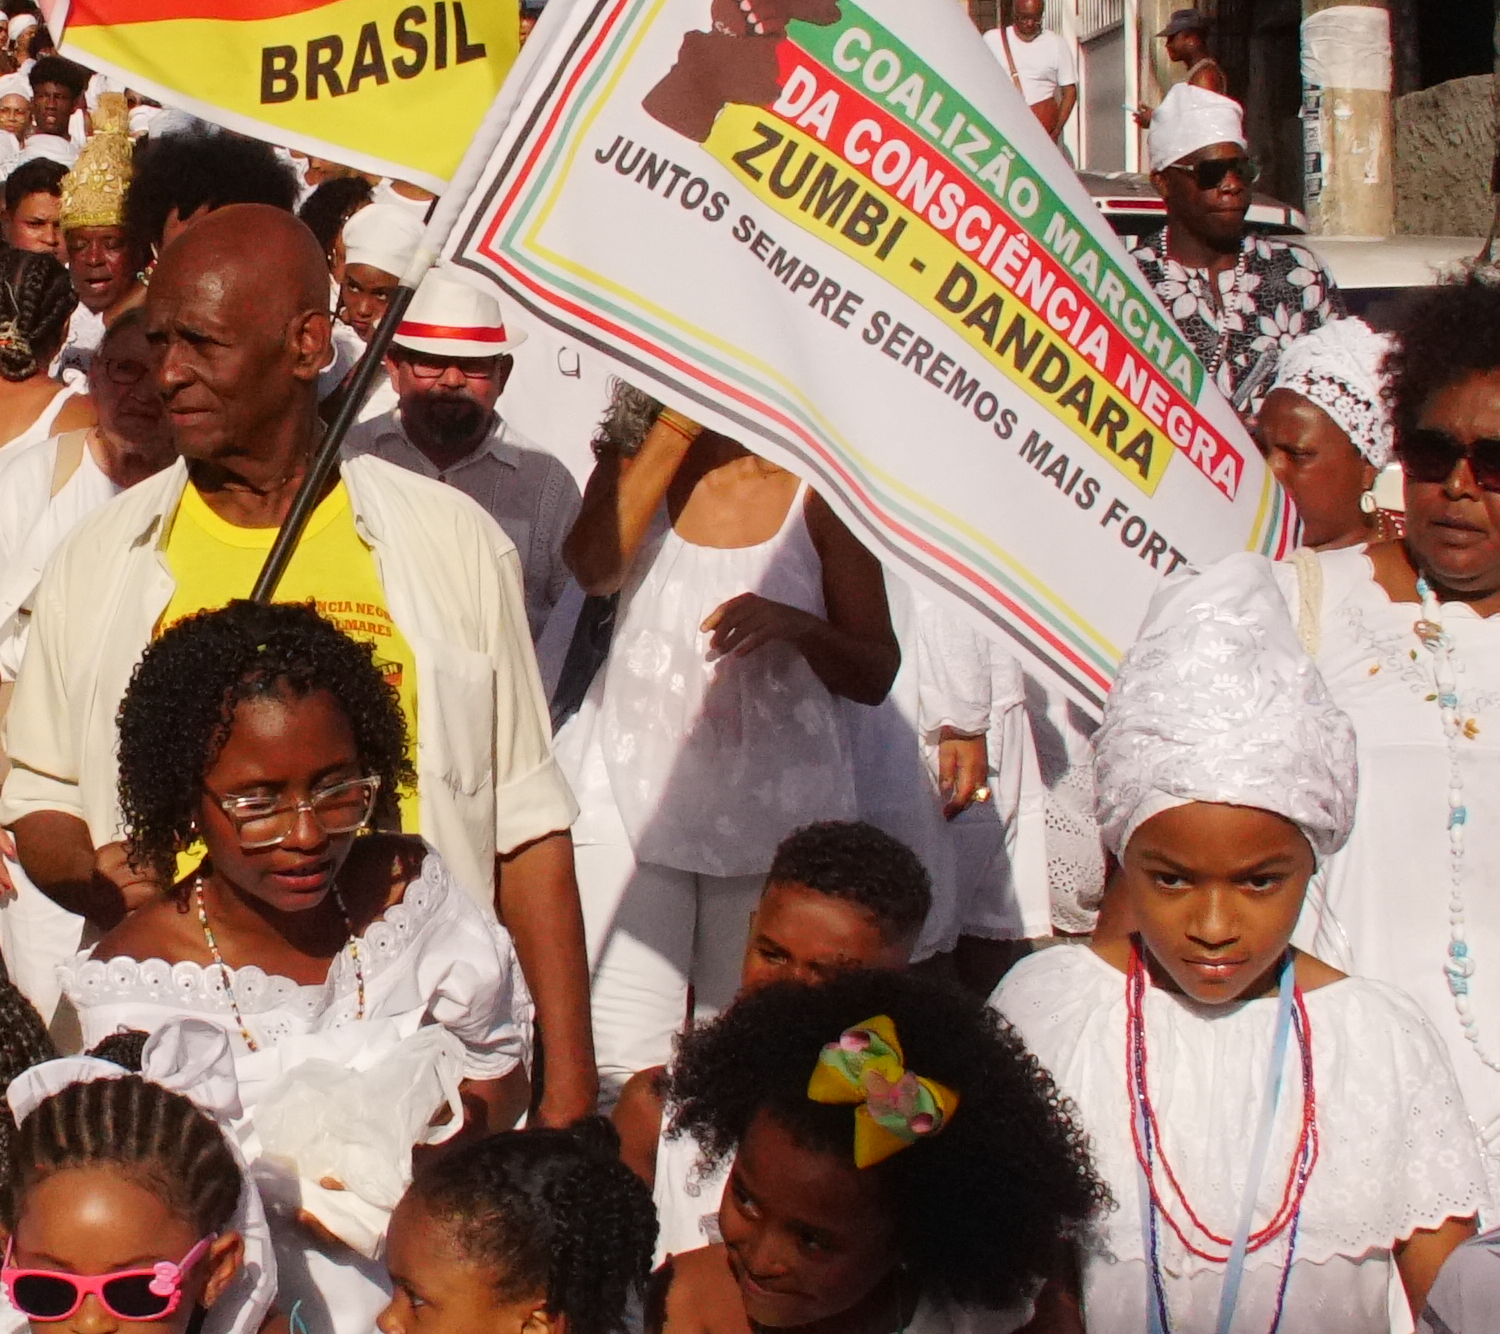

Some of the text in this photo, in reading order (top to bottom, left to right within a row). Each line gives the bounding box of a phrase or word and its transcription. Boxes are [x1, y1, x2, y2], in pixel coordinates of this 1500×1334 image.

[260, 0, 487, 105] BRASIL
[832, 27, 1194, 396] COALIZÃO MARCHA
[594, 135, 1195, 578] JUNTOS SEMPRE SEREMOS MAIS FORT
[731, 121, 909, 262] ZUMBI
[934, 261, 1158, 482] DANDARA
[773, 65, 1241, 500] DA CONSCIÊNCIA NEGRA
